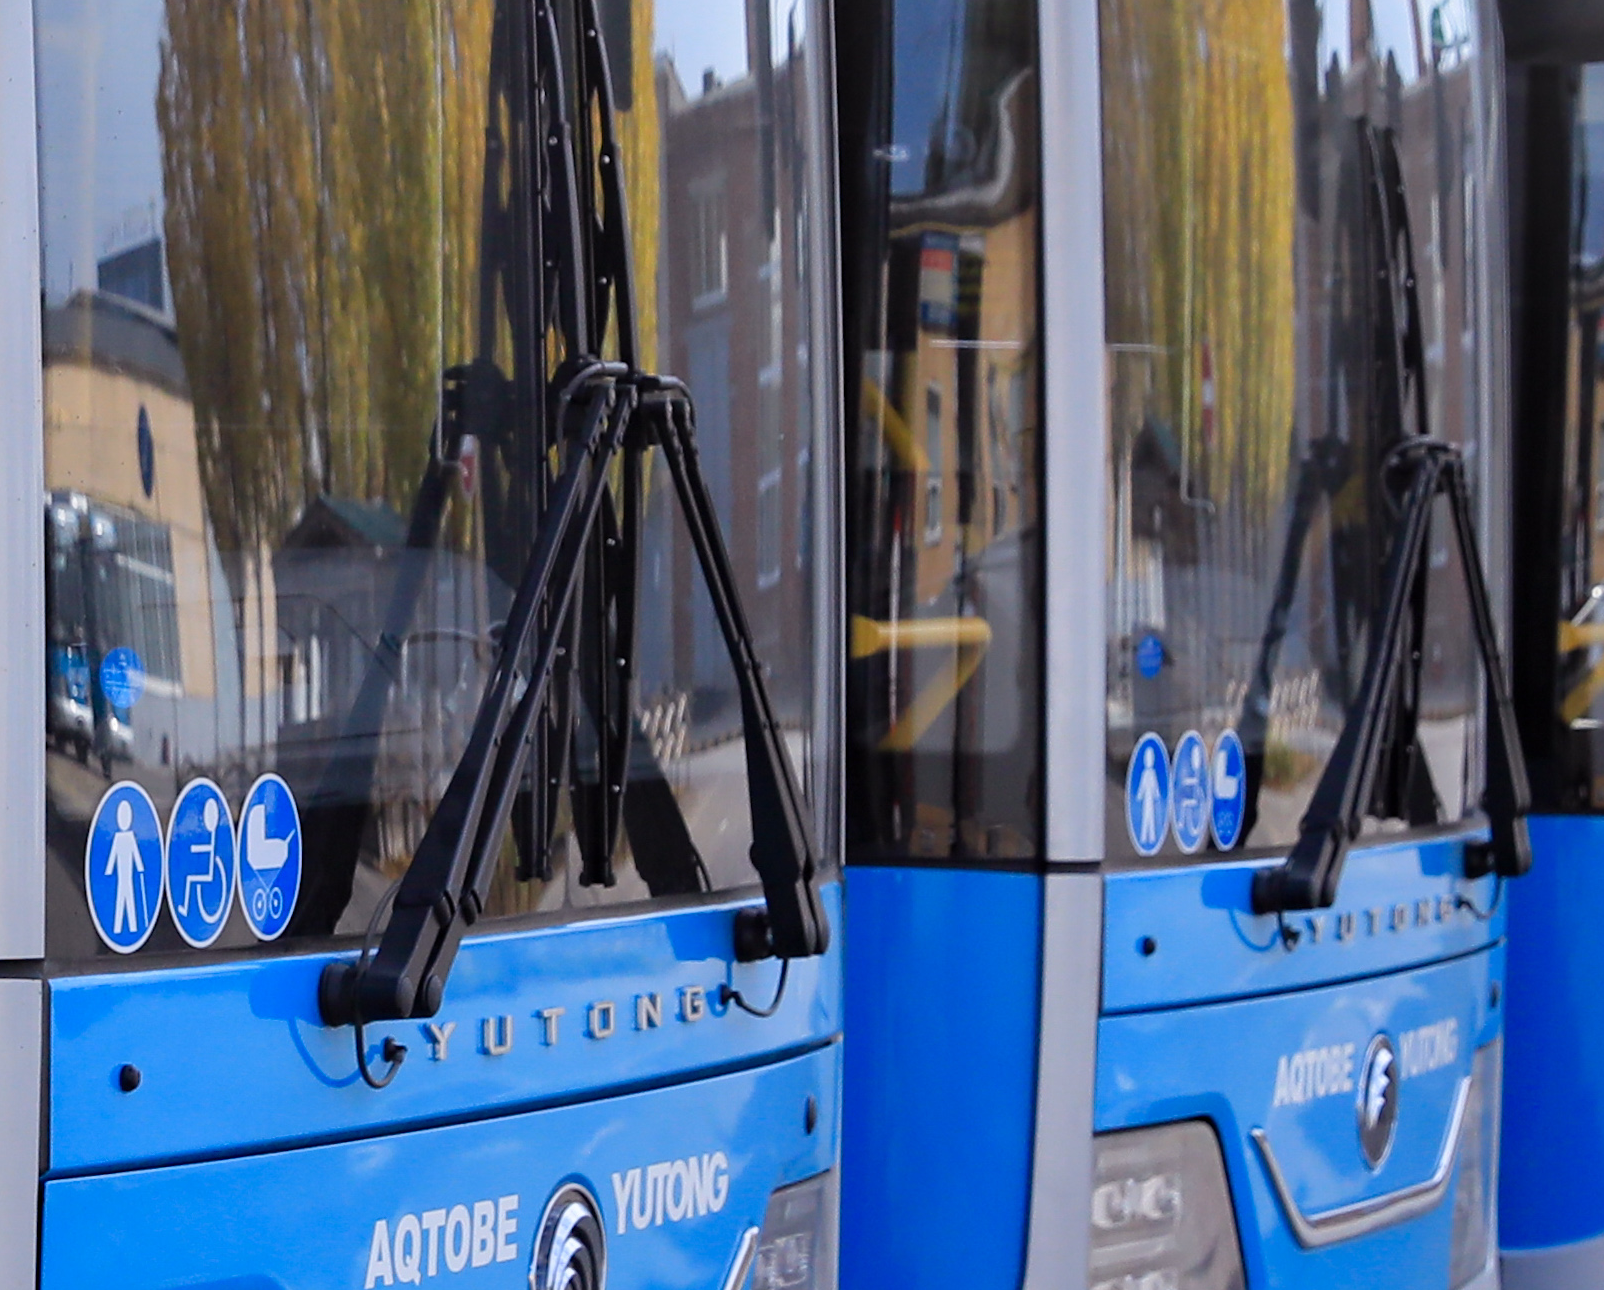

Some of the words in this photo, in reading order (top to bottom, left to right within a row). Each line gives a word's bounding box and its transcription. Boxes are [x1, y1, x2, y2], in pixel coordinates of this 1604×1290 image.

[423, 985, 707, 1061] YUTONG
[365, 1194, 519, 1290] AQTOBE
[611, 1151, 729, 1237] YUTONG
